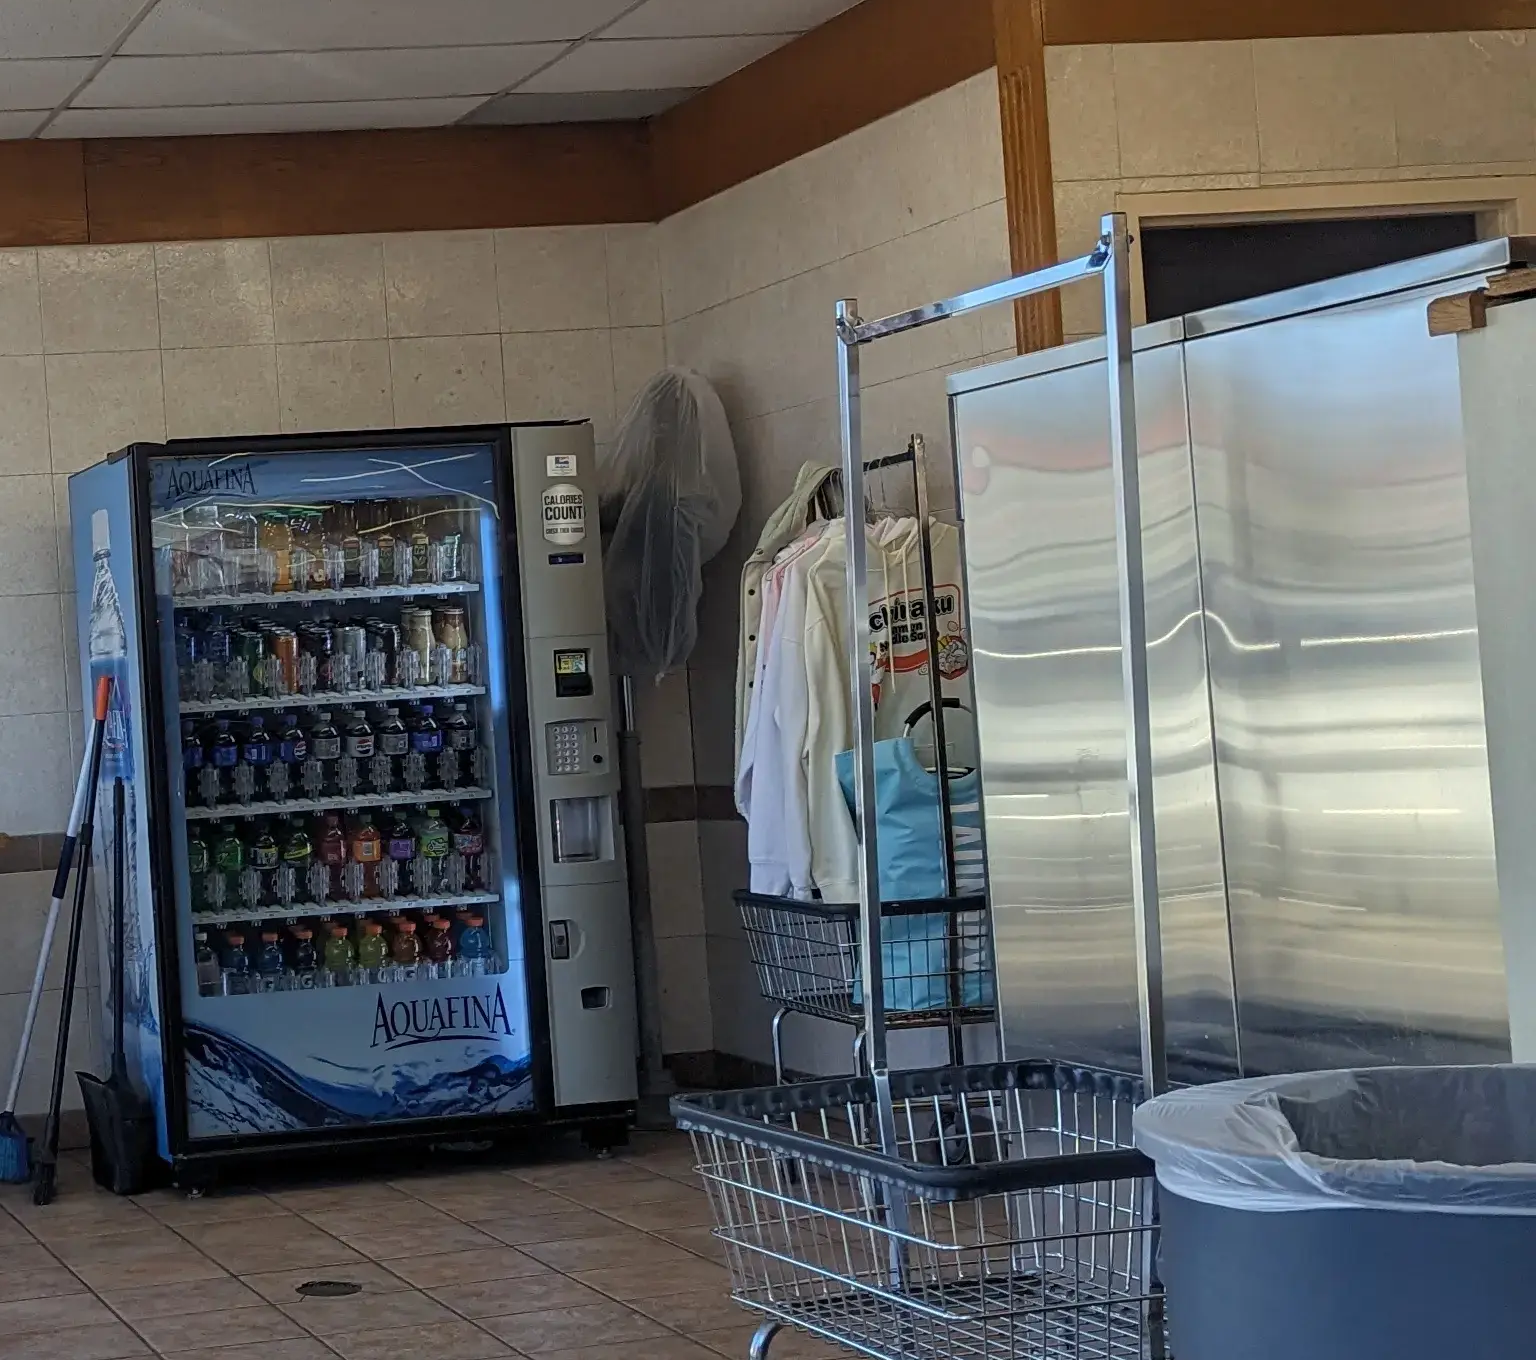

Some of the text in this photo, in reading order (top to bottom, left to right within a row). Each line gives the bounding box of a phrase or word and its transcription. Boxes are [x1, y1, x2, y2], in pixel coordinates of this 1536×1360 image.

[166, 462, 258, 499] AQUAFINA
[544, 494, 583, 505] CALORIES
[545, 506, 583, 520] COUNT
[370, 982, 515, 1051] AQUAFINA
